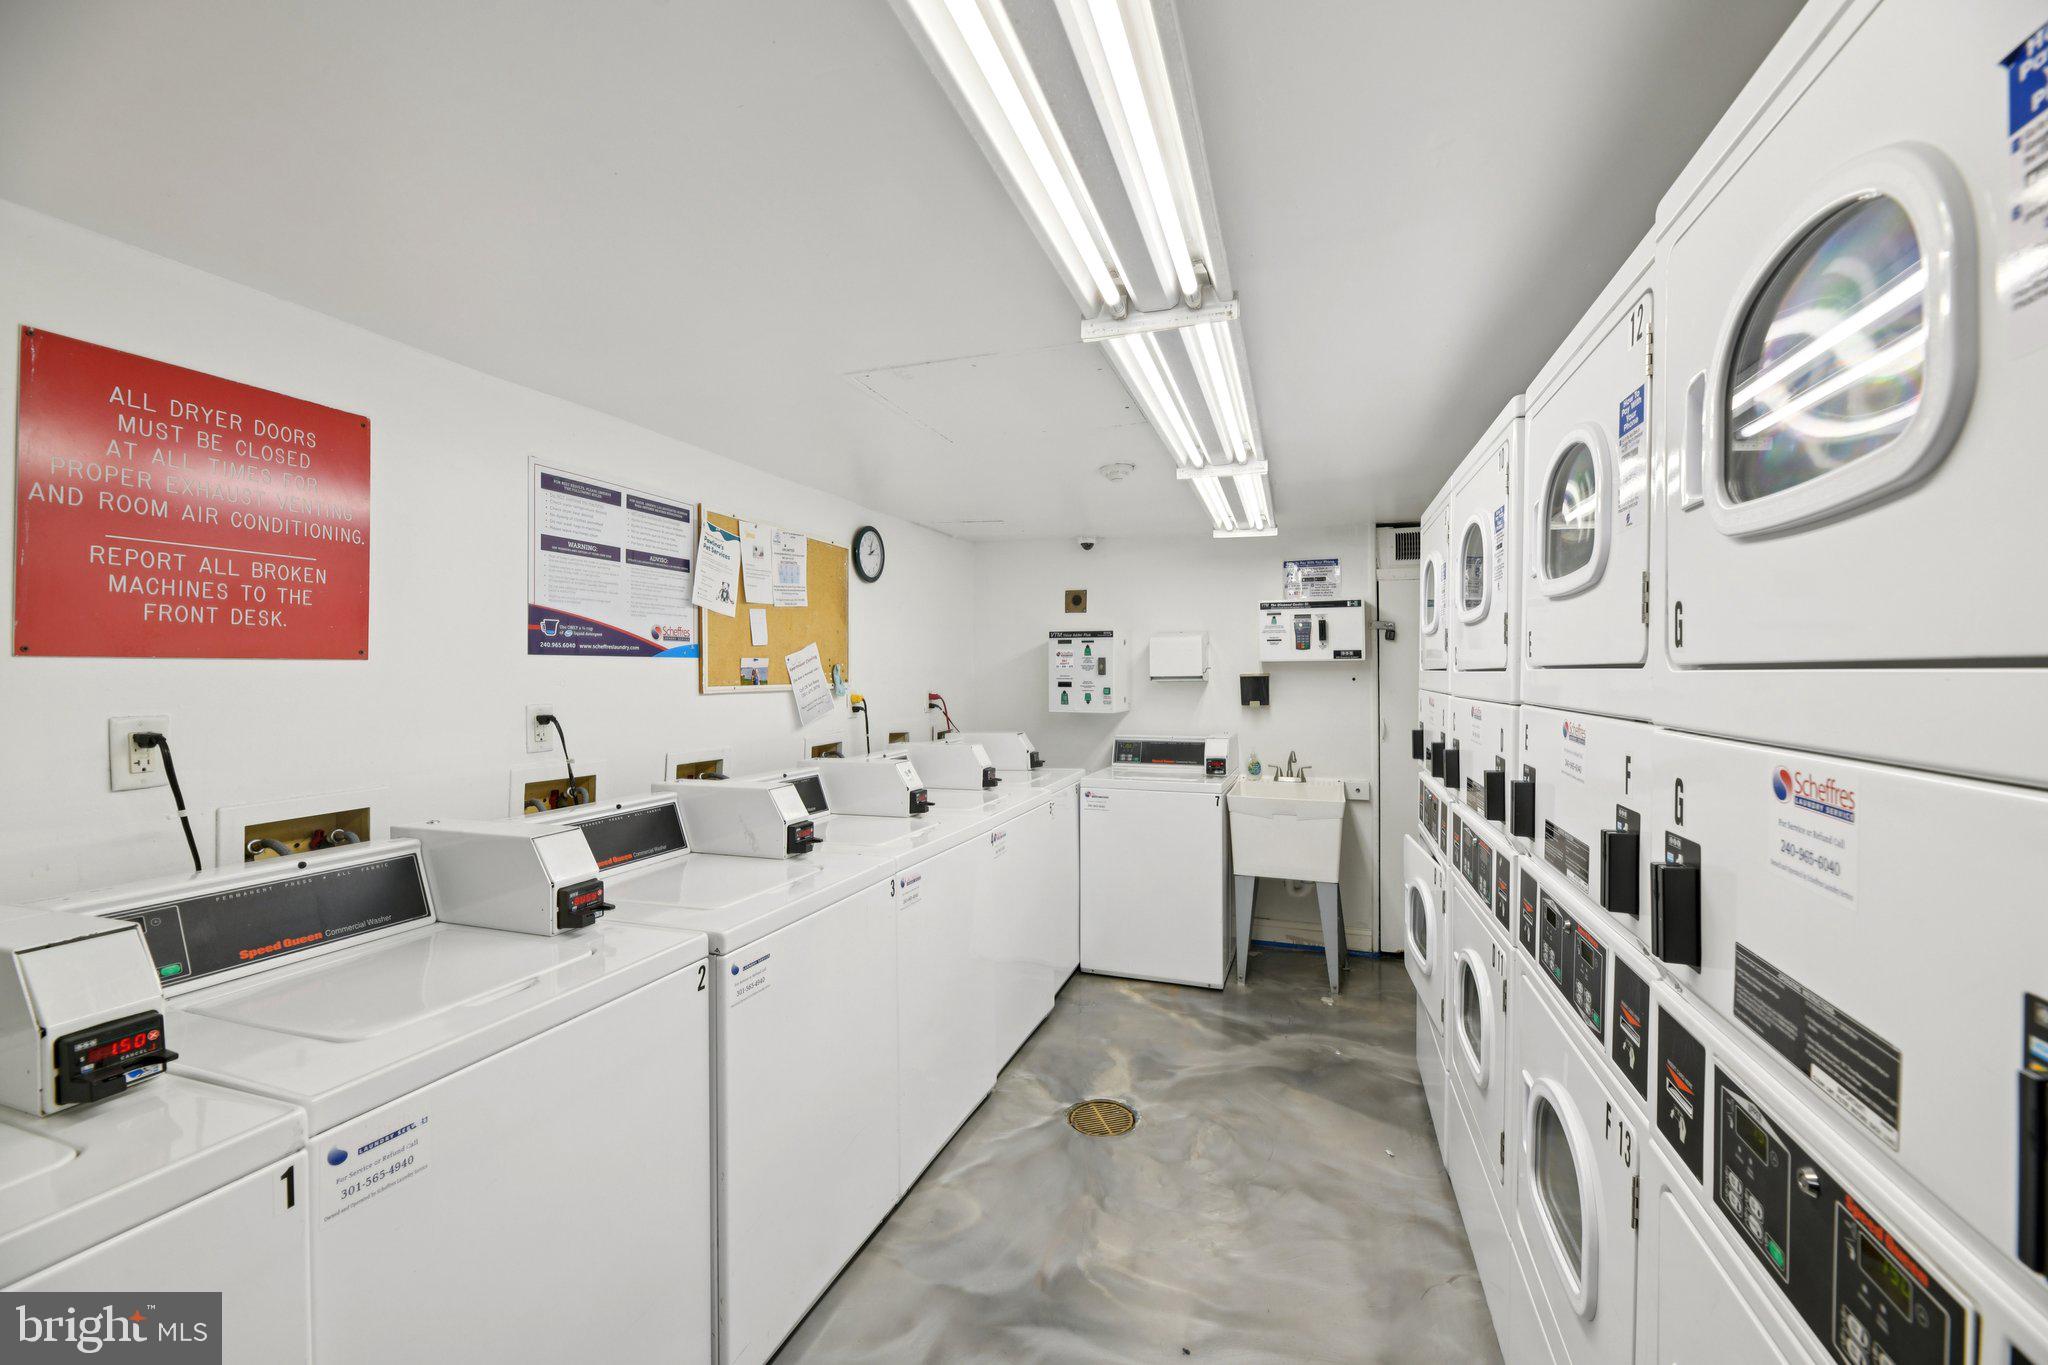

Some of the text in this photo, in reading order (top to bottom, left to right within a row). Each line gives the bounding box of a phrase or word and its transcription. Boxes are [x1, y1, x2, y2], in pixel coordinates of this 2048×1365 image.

[1631, 304, 1643, 347] 12
[109, 386, 317, 448] ALL DRYER DOORS
[118, 414, 311, 469] MUST BE CLOSED
[106, 439, 319, 494] AT ALL TIMES FOR
[50, 456, 353, 522] PROPER EXHAUST VENTING
[28, 482, 366, 545] AND ROOM AIR CONDITIONING.
[90, 545, 327, 584] REPORT ALL BROKEN
[108, 575, 313, 606] MACHINES TO THE
[144, 603, 287, 628] FRONT DESK.
[1675, 601, 1682, 648] G
[1625, 756, 1631, 795] F
[1794, 771, 1855, 810] Scheffres
[1215, 796, 1220, 807] 7
[1674, 777, 1683, 826] G
[1780, 839, 1841, 876] 240-965-6040
[215, 886, 273, 902] PERMANENT
[284, 878, 313, 888] PRESS
[360, 862, 389, 872] FABRIC
[890, 879, 895, 897] 3
[239, 913, 392, 960] Speed Queen Commercial Washer
[697, 965, 706, 992] 2
[120, 1049, 147, 1060] CANCEL
[1606, 1102, 1631, 1168] F 13
[336, 1175, 348, 1185] For
[349, 1162, 373, 1179] Service
[382, 1146, 405, 1162] Refund
[340, 1155, 414, 1200] 301-565-4940
[280, 1165, 295, 1209] 1
